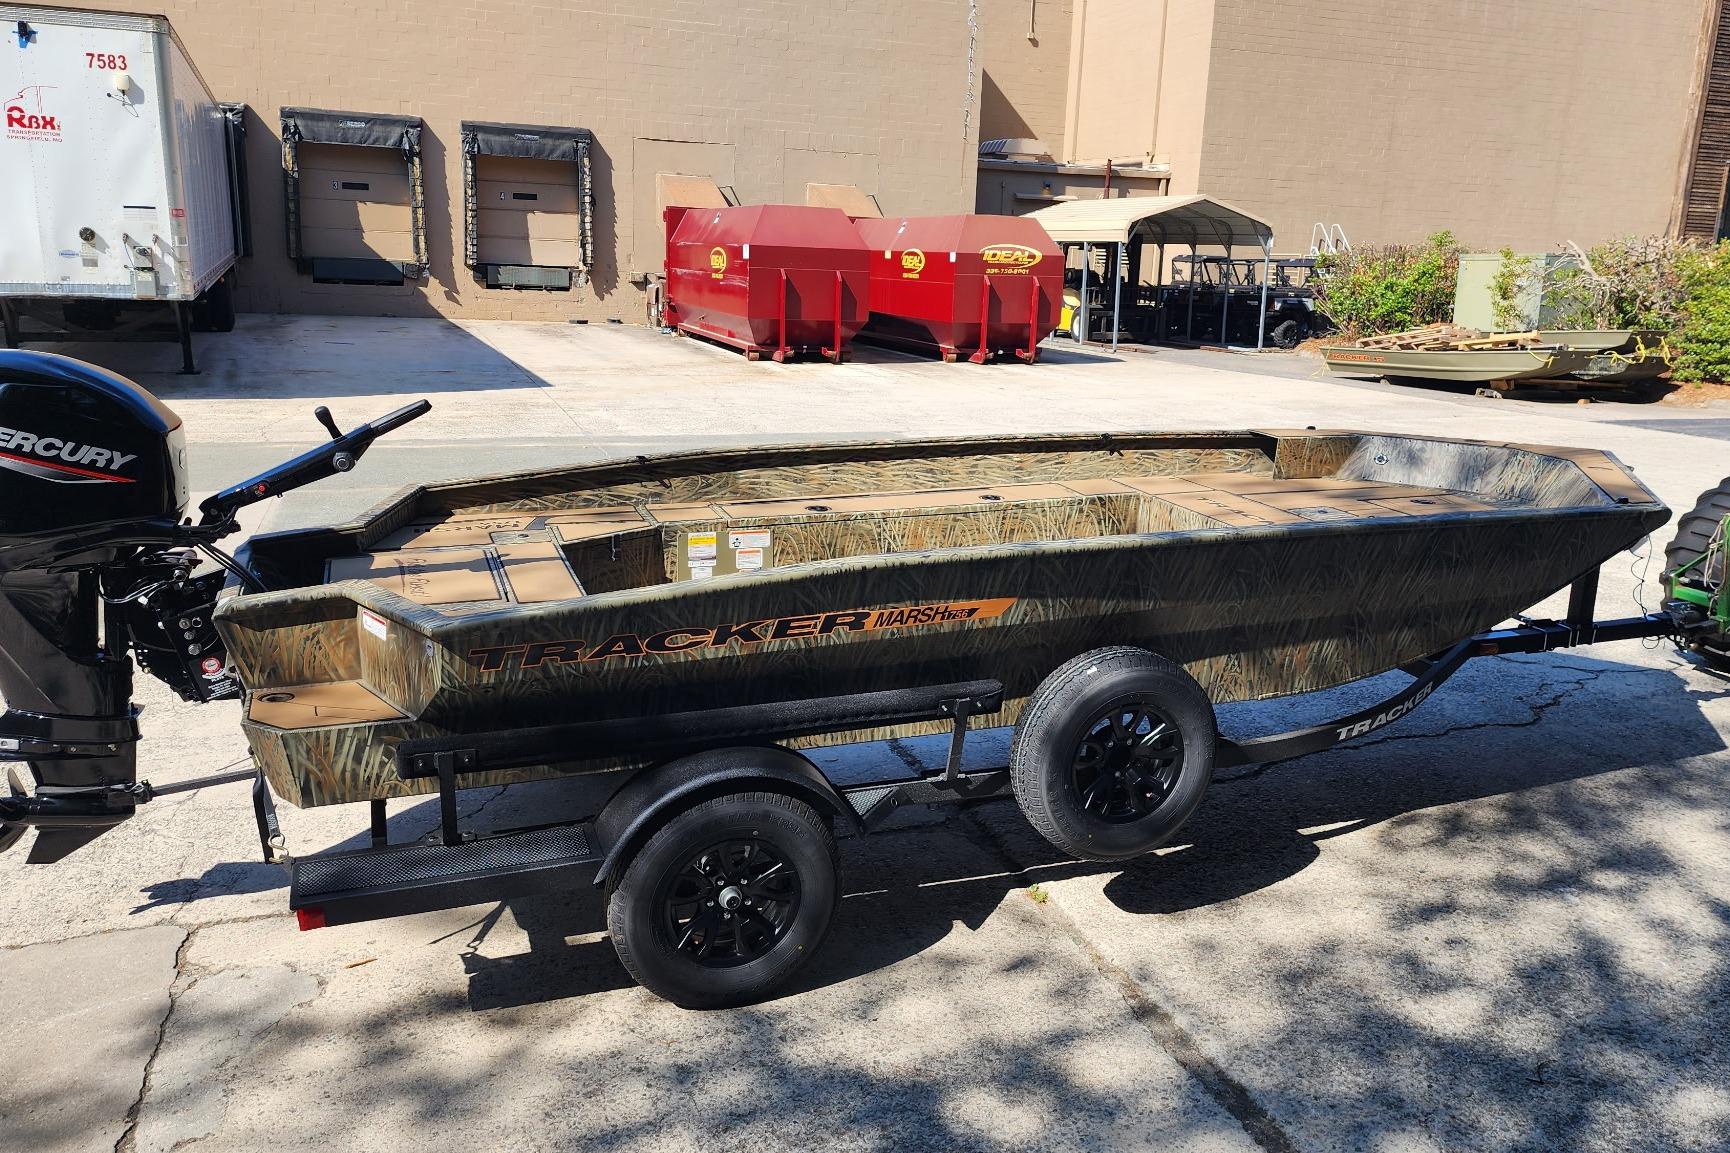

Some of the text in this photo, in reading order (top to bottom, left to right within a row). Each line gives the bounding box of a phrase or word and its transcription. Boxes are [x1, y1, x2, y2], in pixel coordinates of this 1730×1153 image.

[85, 52, 128, 71] 7583
[982, 250, 1034, 262] IDEAL
[0, 426, 138, 470] ERCURY
[468, 605, 968, 674] TRACKER MARSH 1756
[1336, 681, 1433, 741] TRACKER
